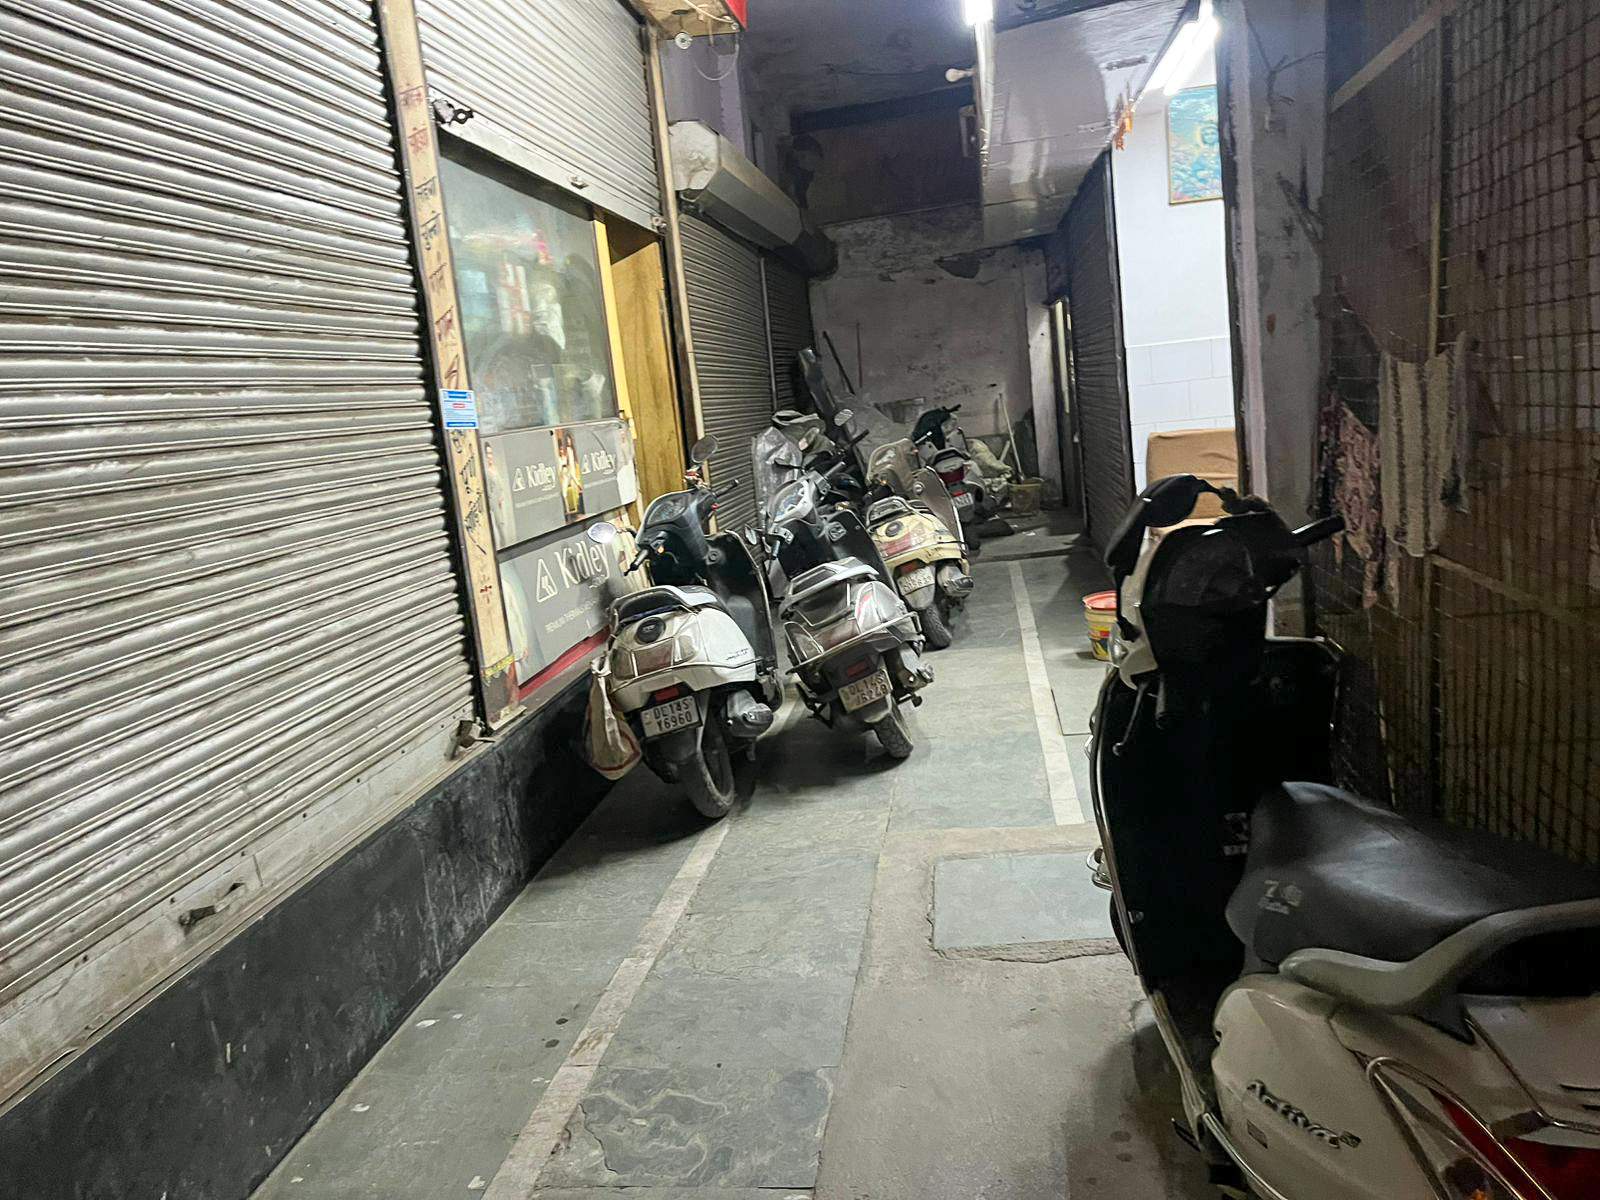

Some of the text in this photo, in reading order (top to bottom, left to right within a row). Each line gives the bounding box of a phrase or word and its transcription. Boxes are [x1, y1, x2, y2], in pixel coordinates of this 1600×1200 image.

[526, 463, 556, 489] Kidley
[555, 540, 611, 589] Kidley
[657, 710, 692, 731] Y6960
